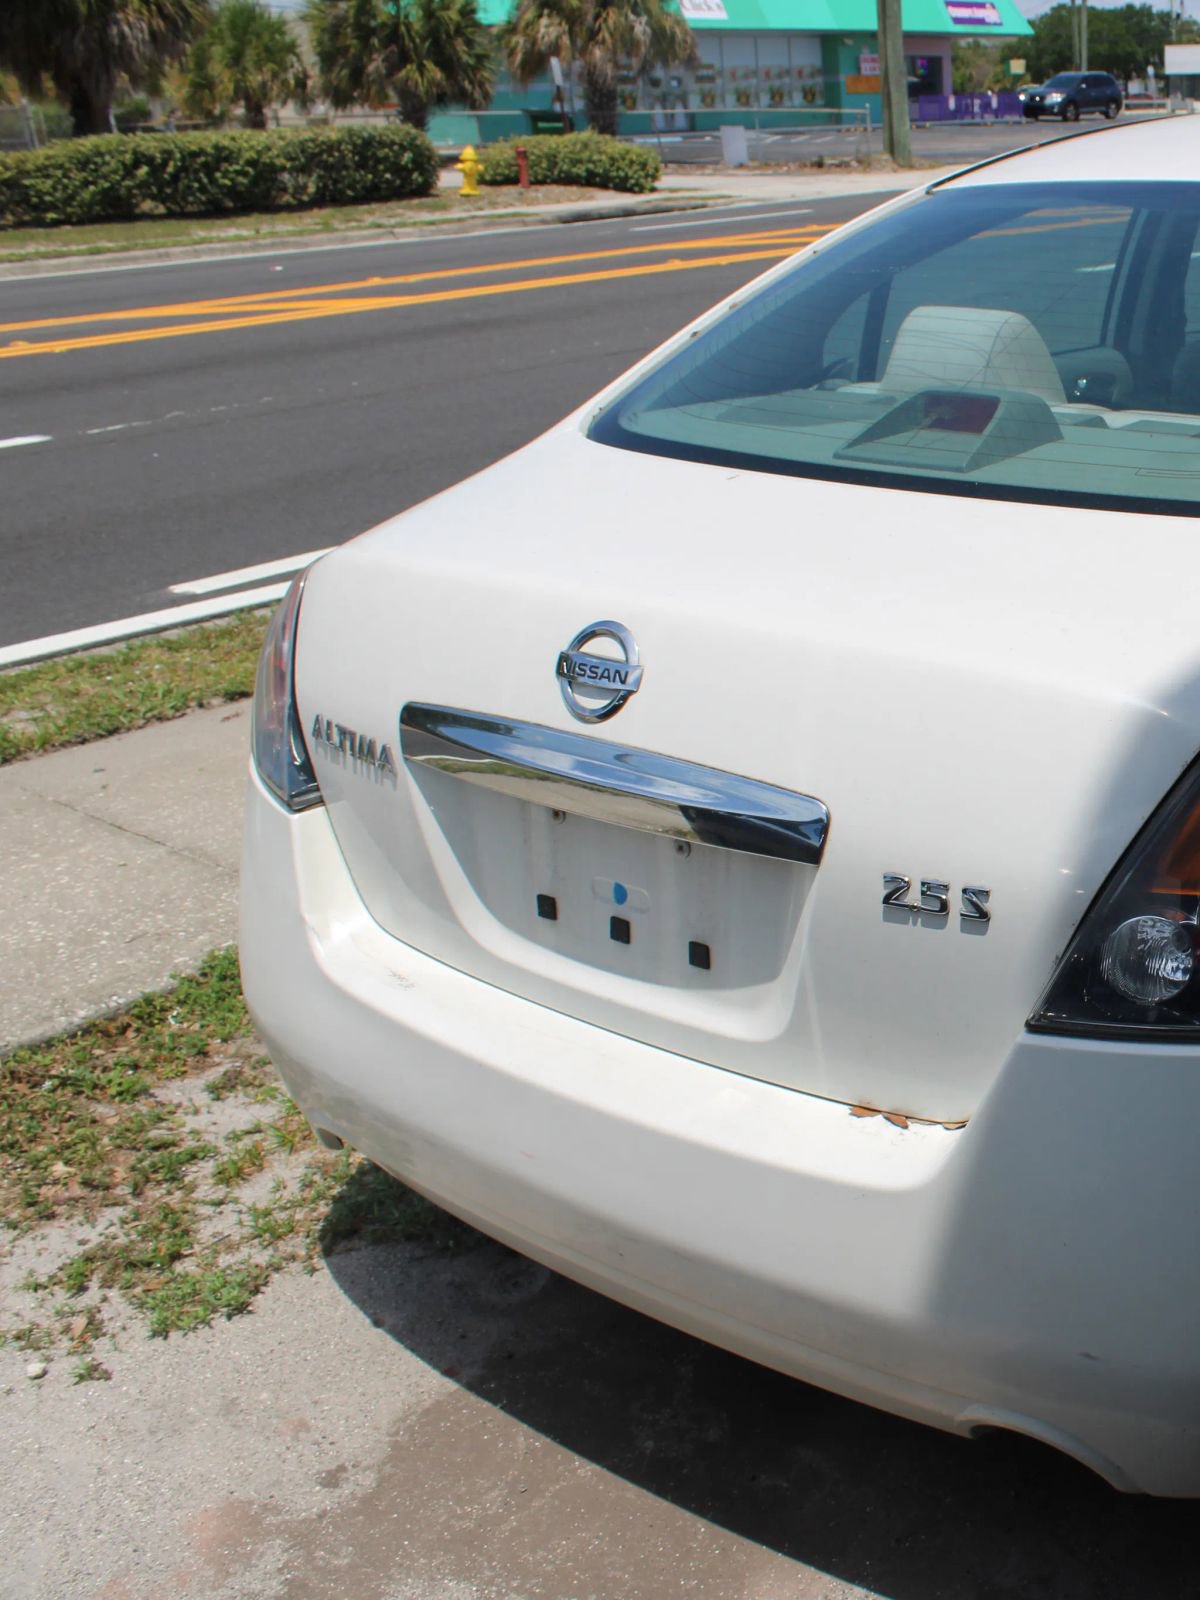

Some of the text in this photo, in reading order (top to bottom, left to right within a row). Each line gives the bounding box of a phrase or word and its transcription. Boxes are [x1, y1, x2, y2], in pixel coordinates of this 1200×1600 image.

[561, 657, 629, 685] NISSAN
[311, 713, 398, 777] ALTIMA
[960, 885, 991, 921] S
